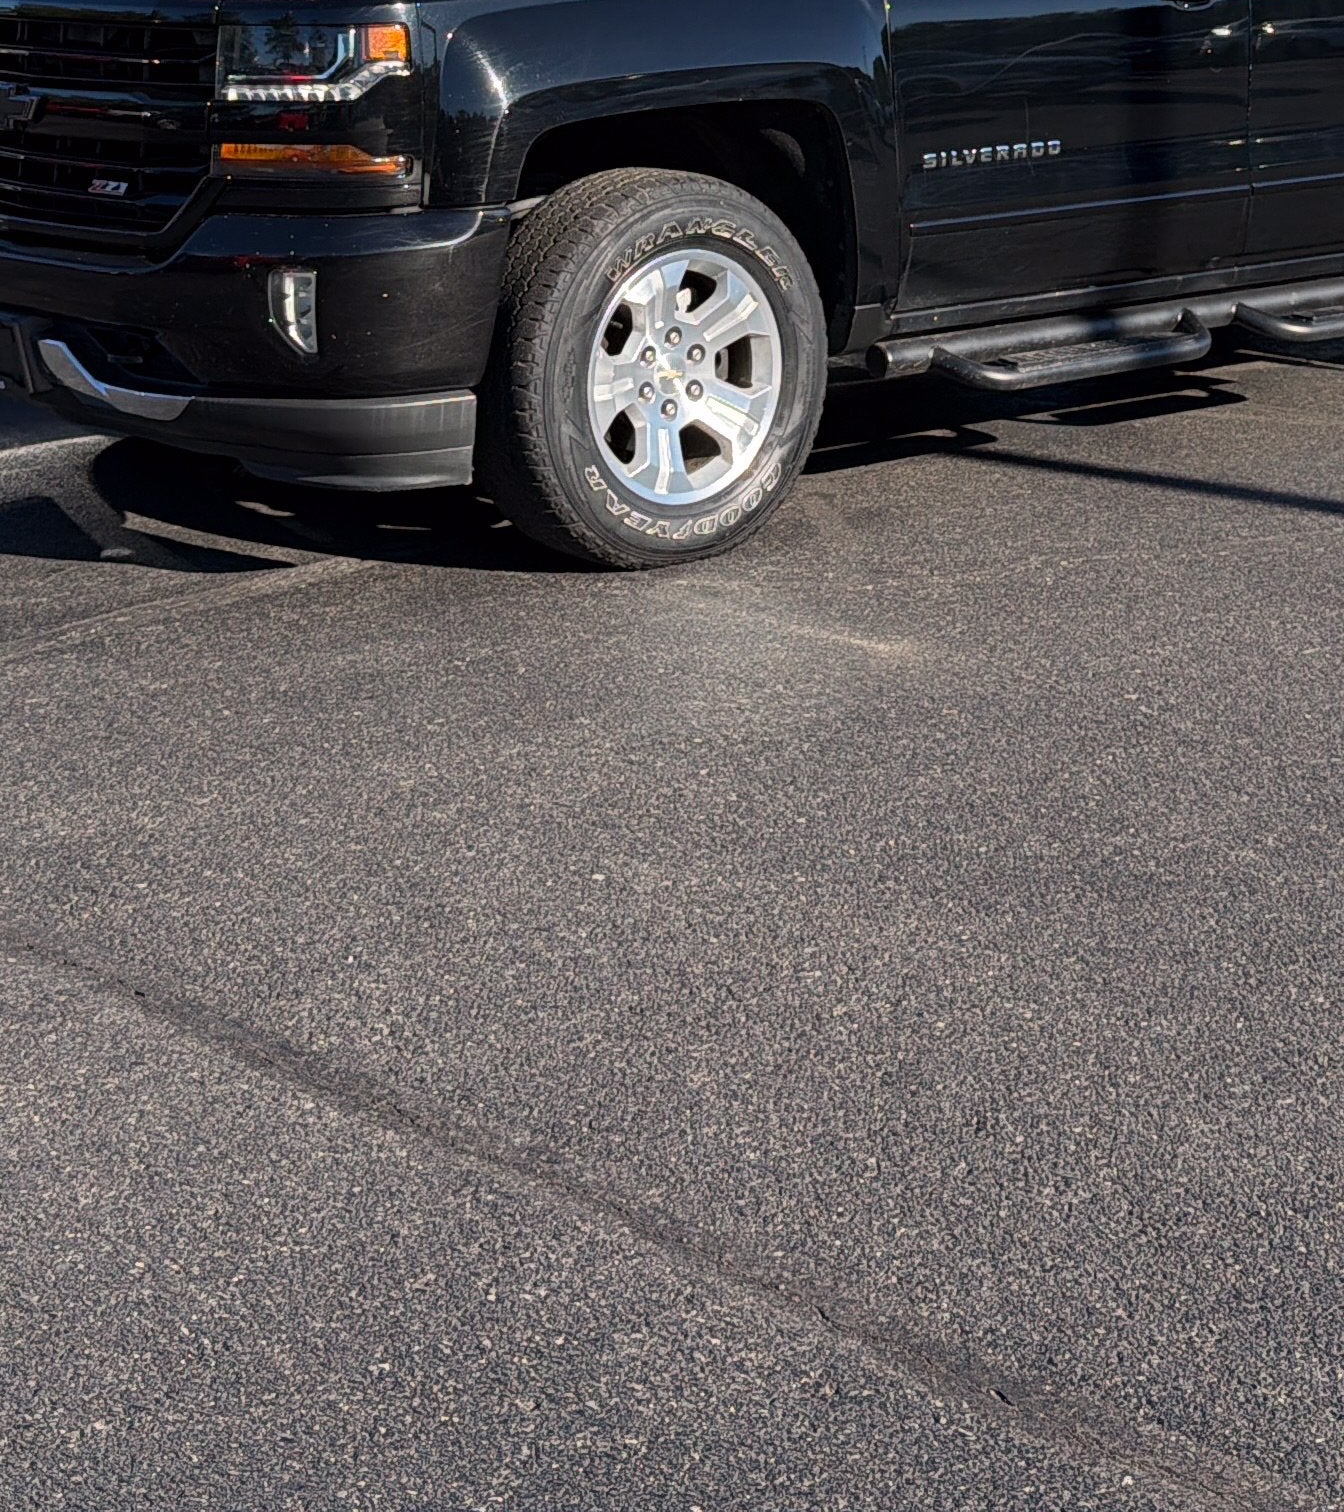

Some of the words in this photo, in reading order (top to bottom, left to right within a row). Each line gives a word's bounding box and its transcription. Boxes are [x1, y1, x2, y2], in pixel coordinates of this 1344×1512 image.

[922, 140, 1061, 169] SILVERADO
[88, 179, 128, 197] Z71
[605, 217, 794, 291] WRANGLER
[584, 462, 782, 540] GOODYEAR
